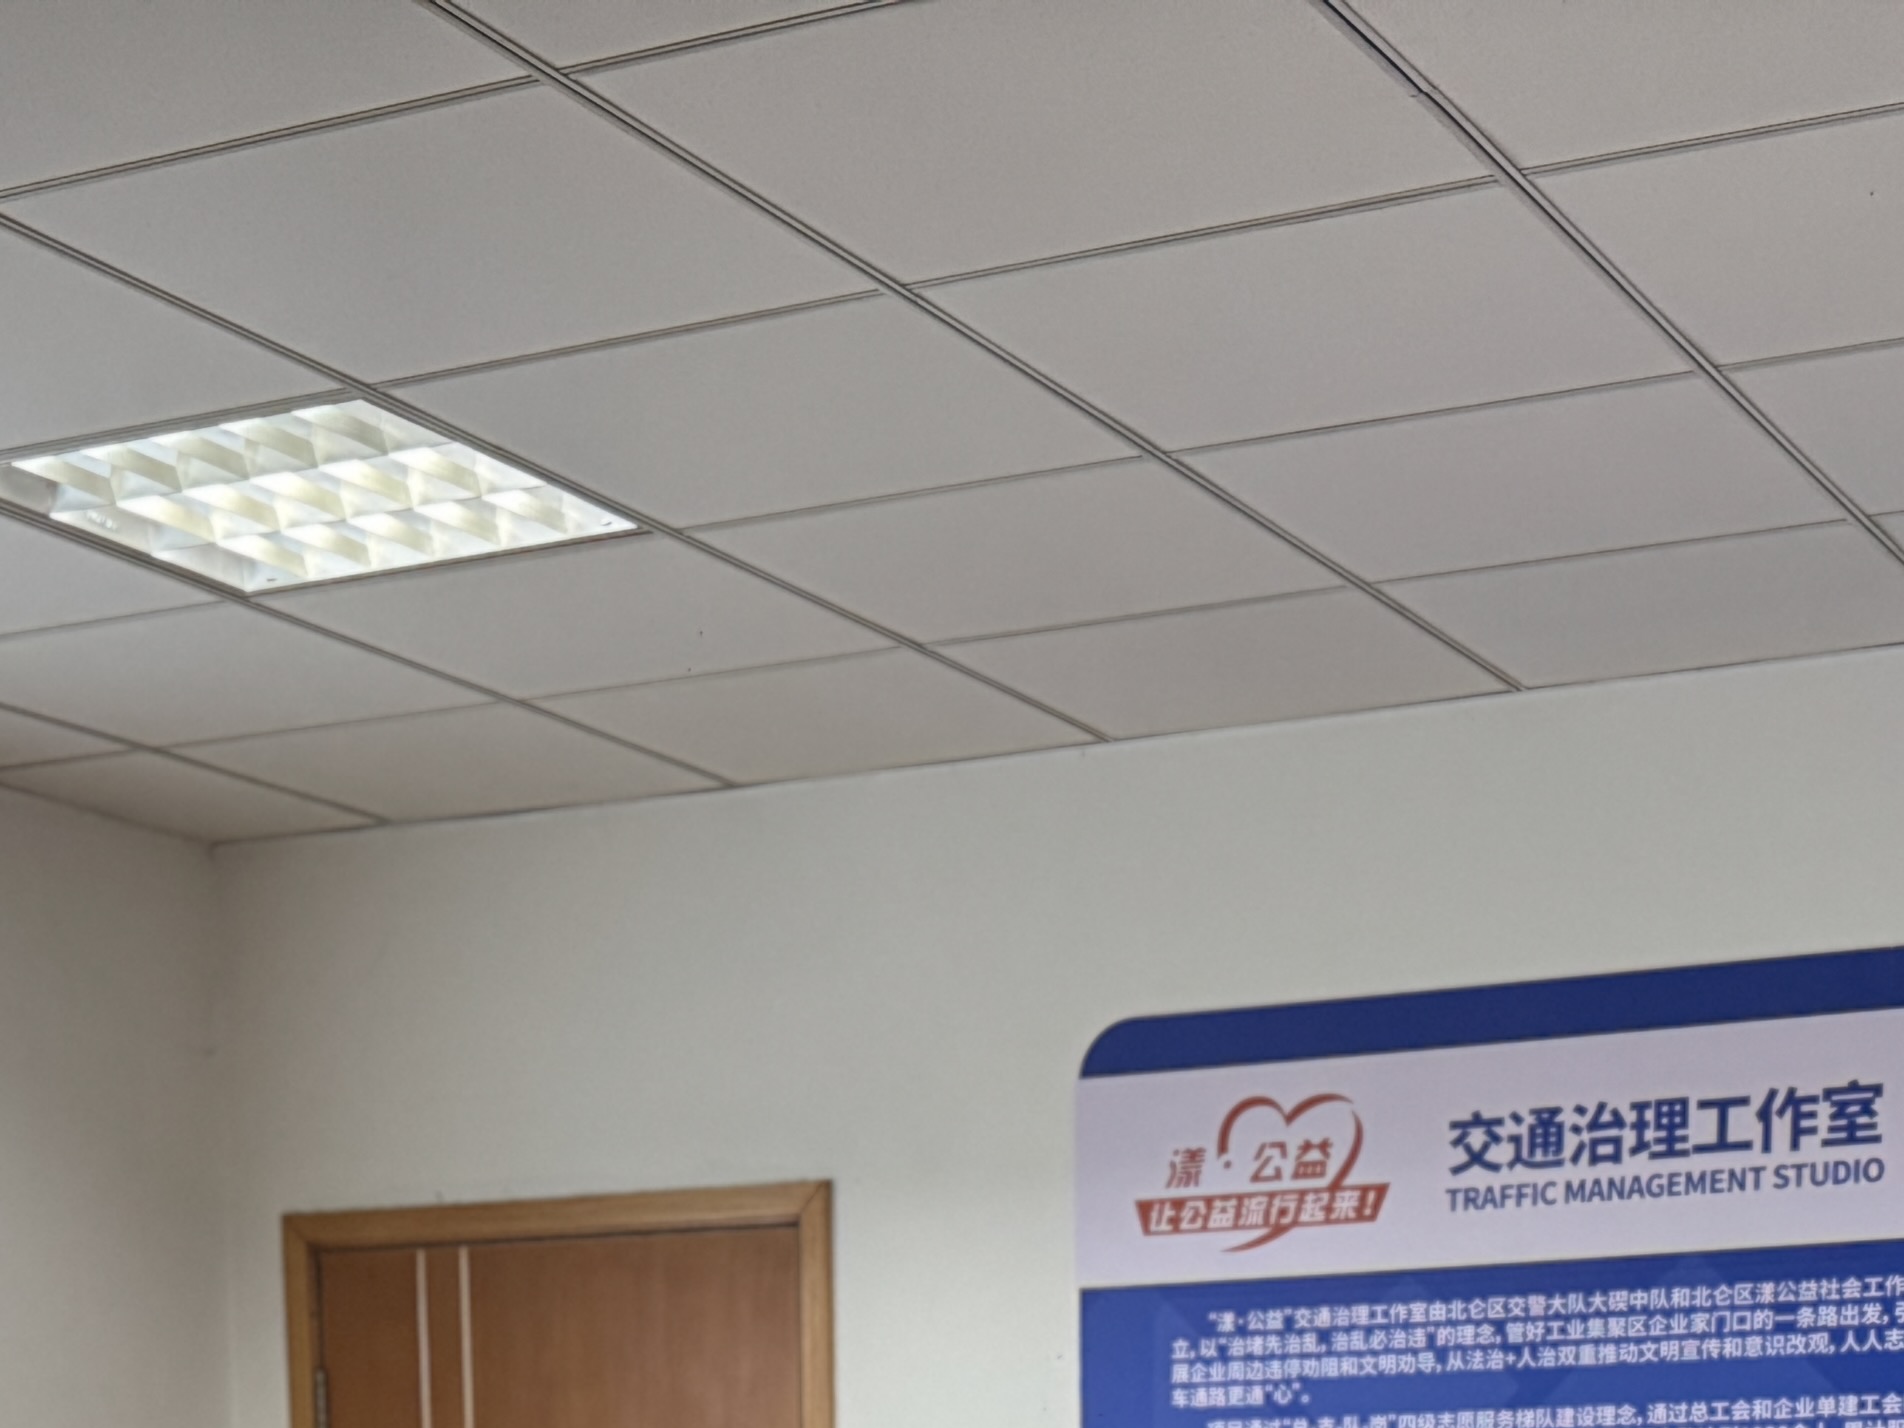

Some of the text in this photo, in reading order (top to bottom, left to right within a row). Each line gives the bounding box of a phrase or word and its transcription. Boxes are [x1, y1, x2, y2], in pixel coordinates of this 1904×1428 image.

[1448, 1079, 1884, 1176] 交通治理工作室
[1446, 1157, 1886, 1213] TRAFFIC MANAGEMENT STUDIO
